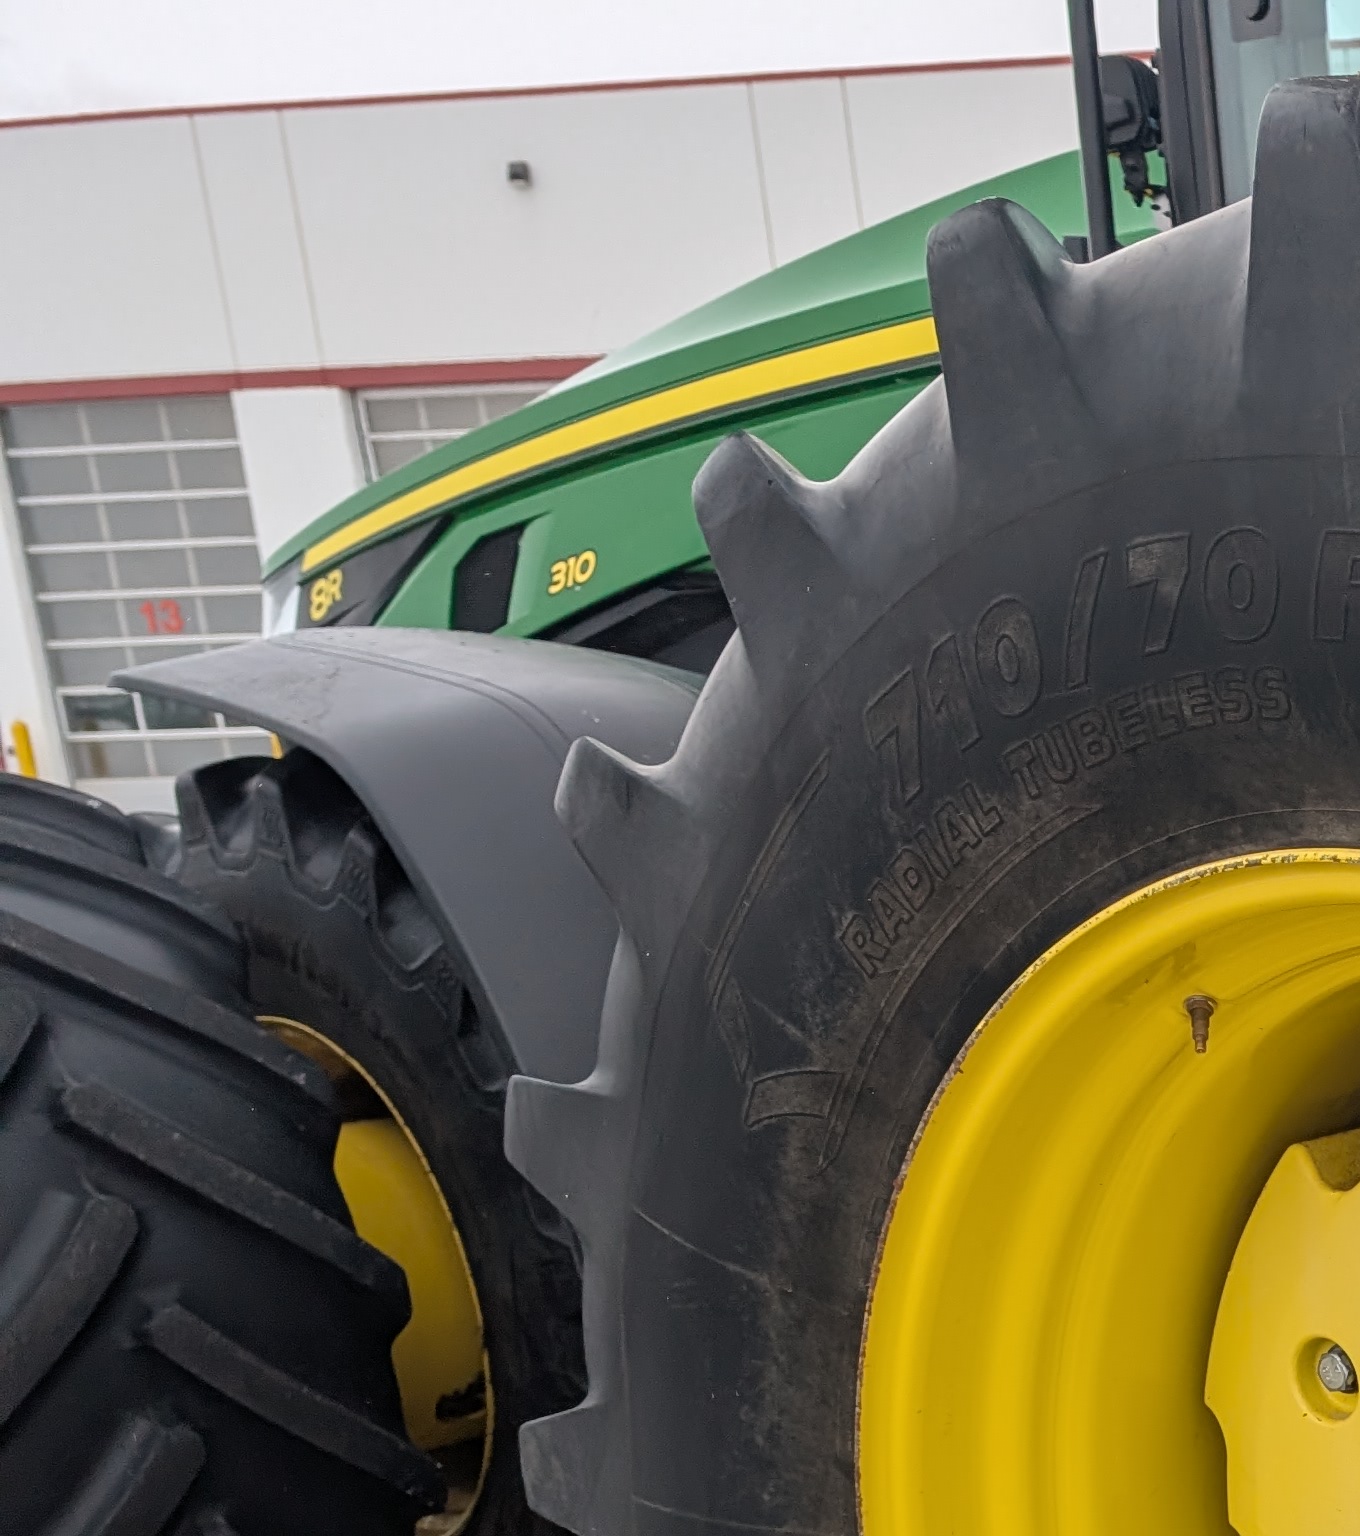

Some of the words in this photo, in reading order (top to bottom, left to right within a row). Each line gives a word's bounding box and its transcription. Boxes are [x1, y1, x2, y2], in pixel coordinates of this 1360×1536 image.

[309, 568, 343, 622] 8R
[547, 549, 597, 595] 310
[139, 598, 185, 634] 13
[839, 781, 1004, 979] RADIAL
[1002, 665, 1294, 800] TUBELESS
